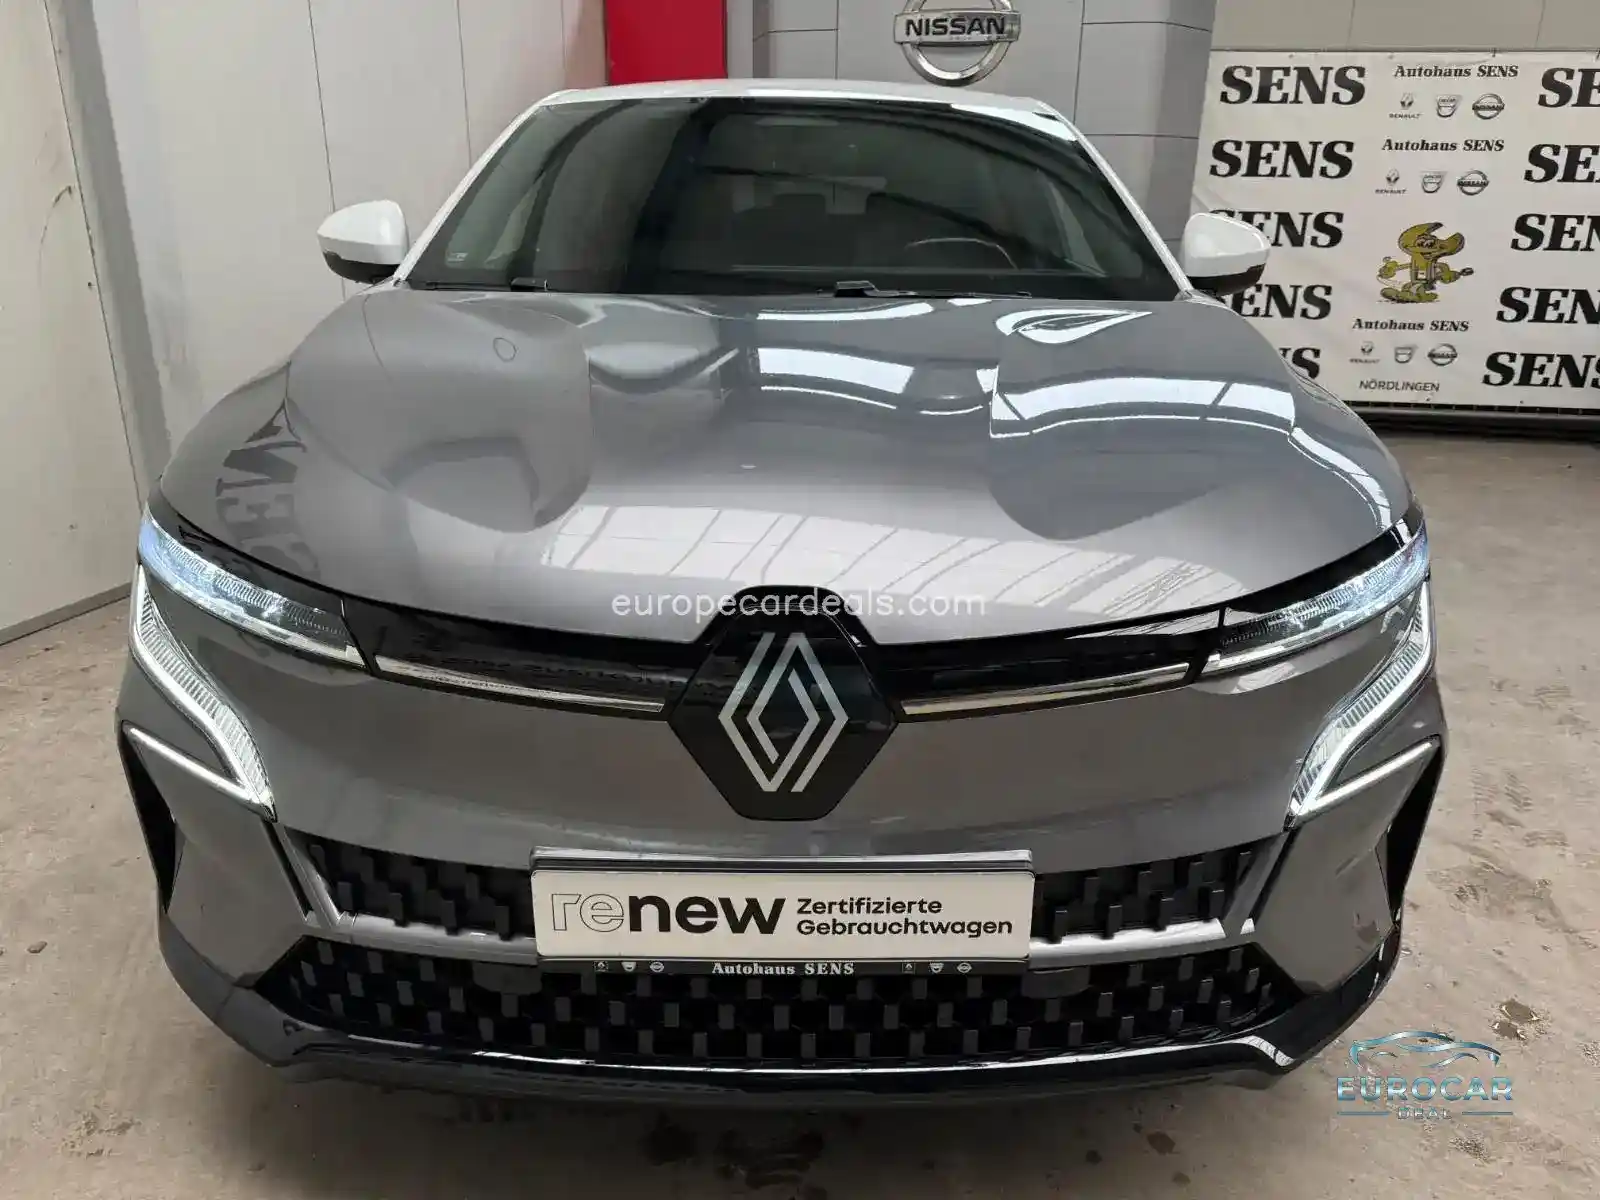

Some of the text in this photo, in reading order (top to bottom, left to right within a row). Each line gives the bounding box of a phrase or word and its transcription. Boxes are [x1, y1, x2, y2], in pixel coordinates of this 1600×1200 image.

[905, 18, 1005, 36] NISSAN
[1394, 65, 1519, 78] Autohaus SENS
[1219, 65, 1366, 106] SENS
[1381, 139, 1505, 151] Autohaus SENS
[1209, 139, 1354, 179] SENS
[1524, 144, 1600, 183] SE
[1217, 284, 1332, 320] ENS
[1352, 318, 1470, 332] Autohaus SENS
[1482, 351, 1600, 389] SEN
[1359, 379, 1440, 392] NÖRDLINGEN
[551, 893, 942, 934] renew Zertifizierte
[797, 918, 1012, 938] Gebrauchtwagen
[711, 961, 855, 976] Autohaus SENS
